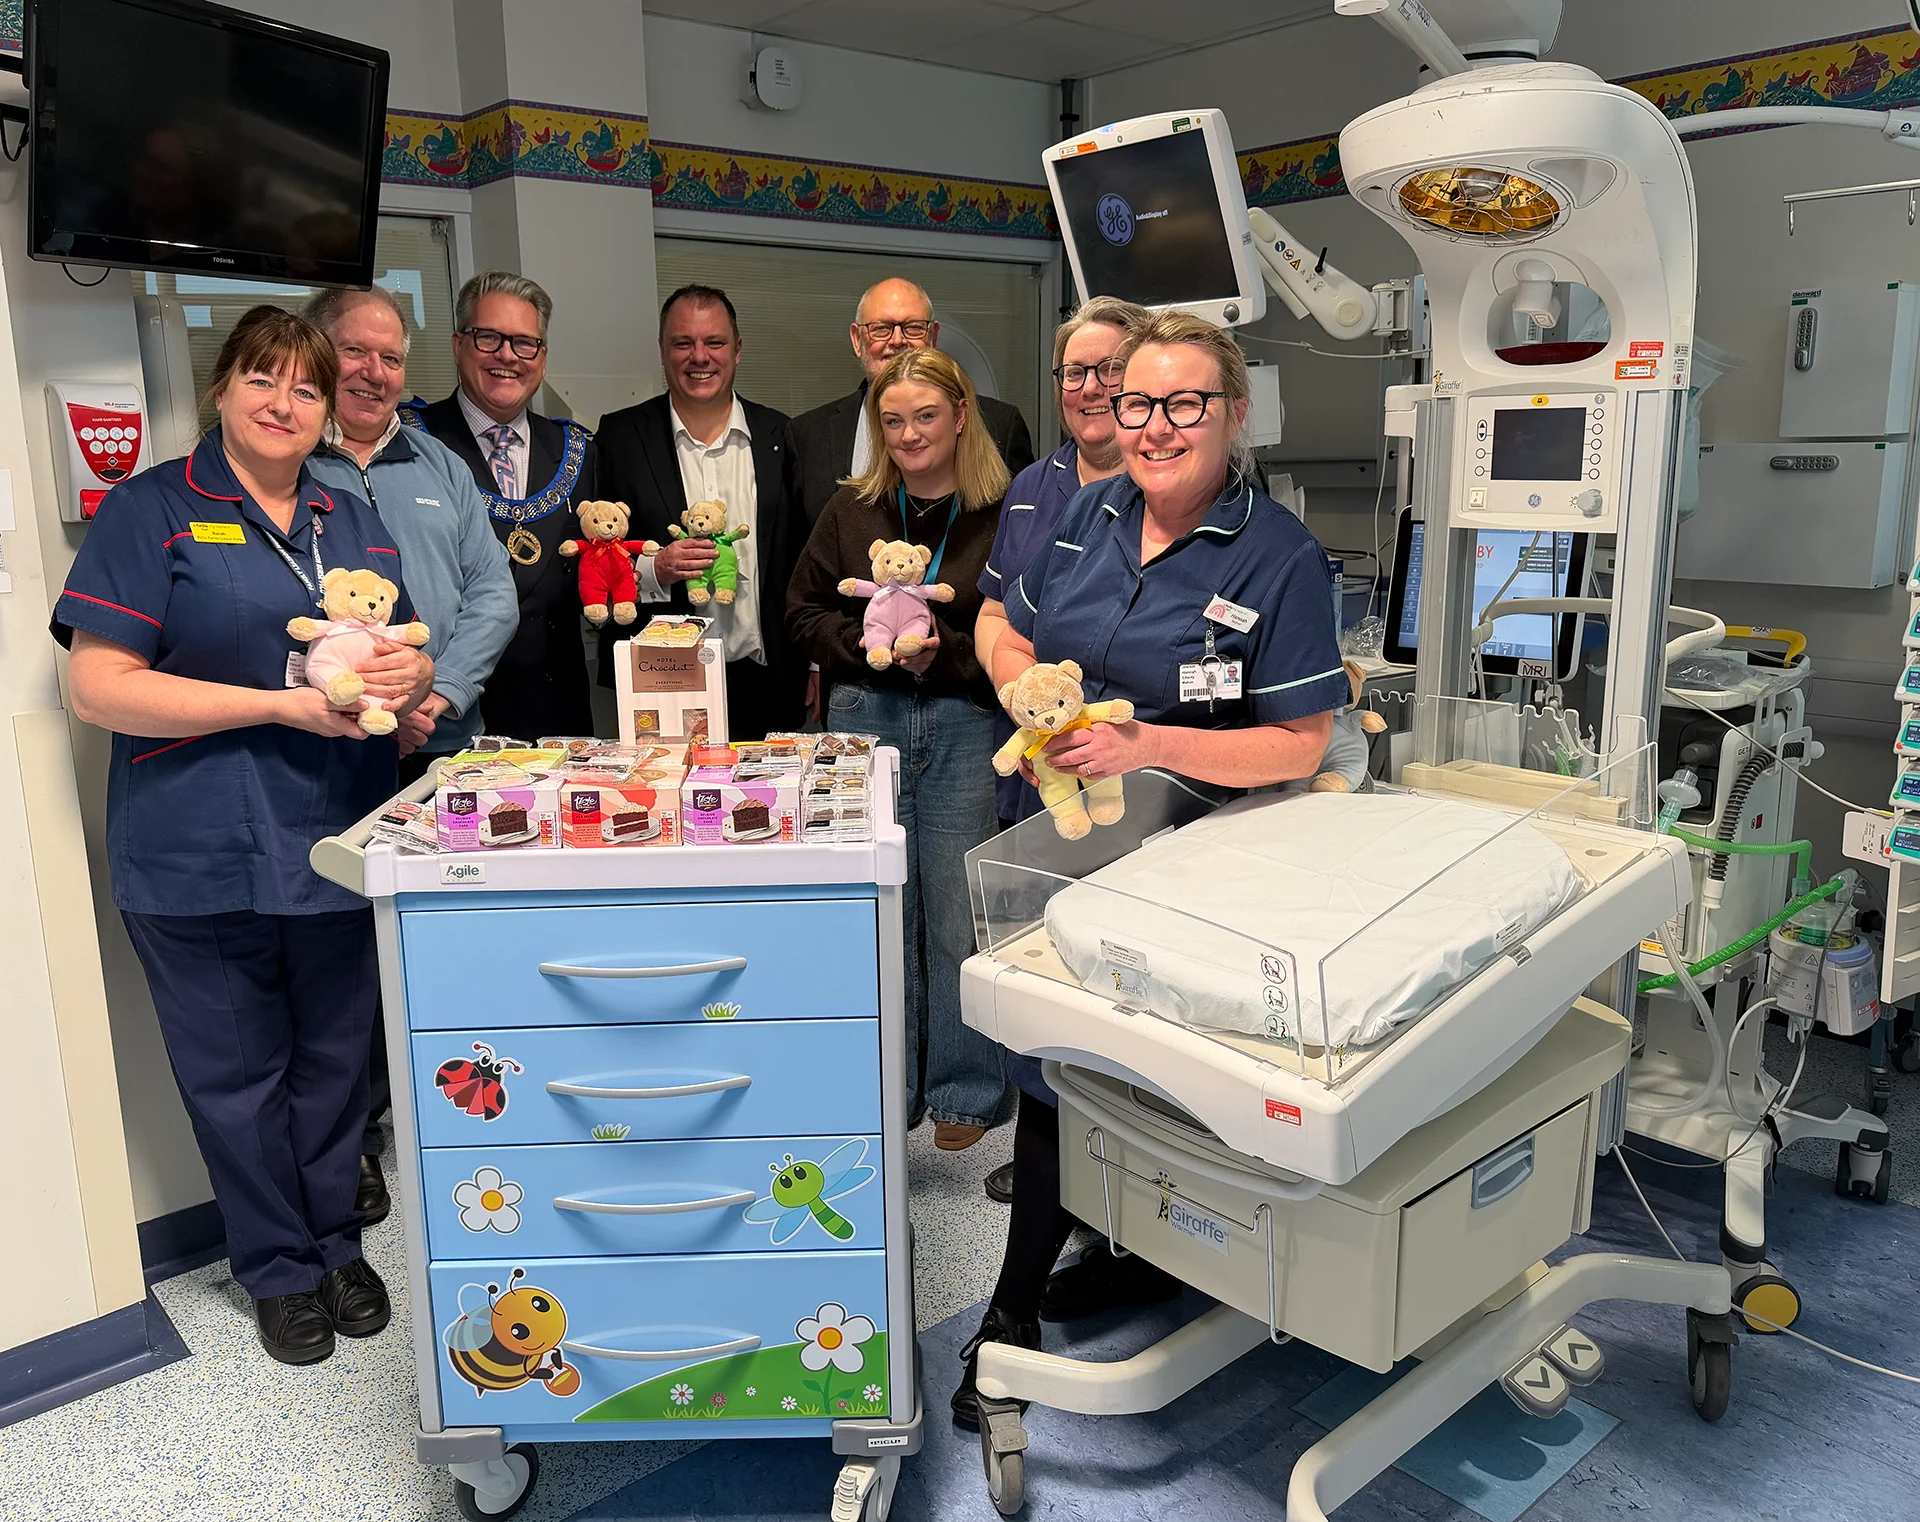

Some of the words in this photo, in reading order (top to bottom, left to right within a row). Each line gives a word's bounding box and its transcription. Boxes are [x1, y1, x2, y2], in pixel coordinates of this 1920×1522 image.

[213, 256, 235, 265] TOSHIBA
[1792, 289, 1822, 298] denward
[1440, 381, 1460, 390] Giraffe
[1231, 613, 1248, 623] Hannah
[1523, 664, 1547, 677] MRI
[446, 864, 480, 879] Agile
[1170, 1203, 1224, 1243] Giraffe
[1170, 1219, 1195, 1238] Warmer
